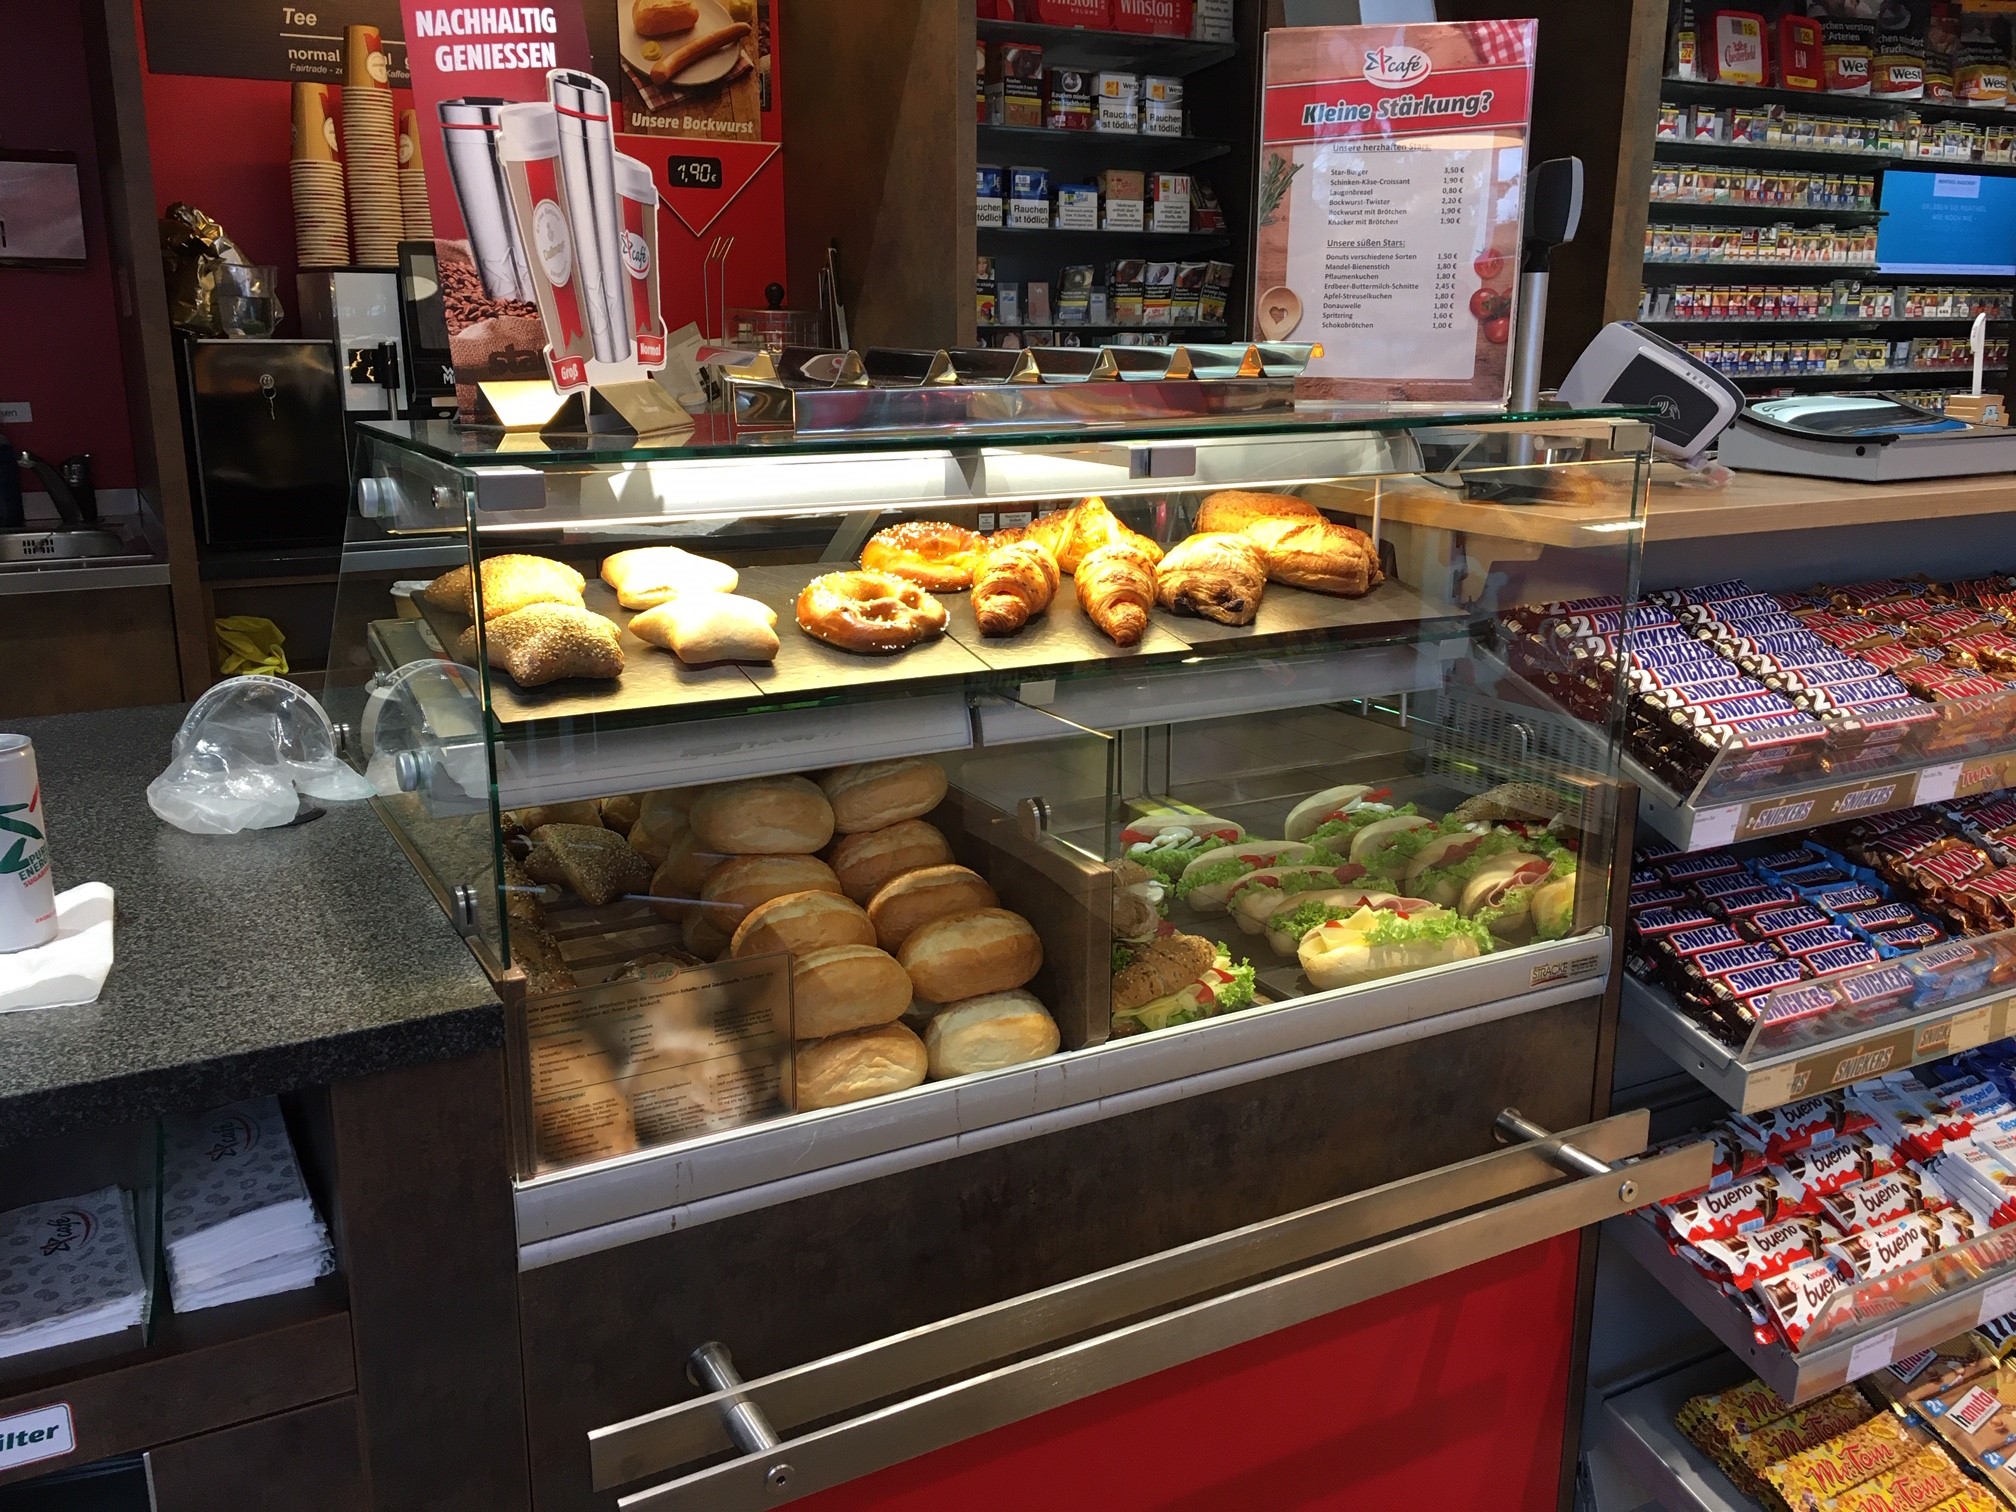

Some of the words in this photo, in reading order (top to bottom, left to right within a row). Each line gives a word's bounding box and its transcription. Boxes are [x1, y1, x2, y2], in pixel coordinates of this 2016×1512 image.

[283, 8, 317, 26] Tee
[415, 8, 557, 37] NACHHALTIG
[288, 49, 340, 62] normal
[290, 63, 327, 74] Fairtrade
[435, 42, 556, 72] GENIESSEN
[1388, 55, 1422, 78] café
[1893, 69, 1921, 79] West
[1103, 110, 1136, 122] Rauchen
[1303, 101, 1371, 124] Kleine
[1377, 91, 1493, 119] Stärkung?
[632, 113, 679, 129] Unsere
[683, 116, 753, 133] Bockwurst
[1333, 144, 1361, 152] Unsere
[1363, 143, 1406, 152] herzhaften
[1014, 205, 1047, 214] Rauchen
[1357, 239, 1380, 247] süßen
[1383, 239, 1405, 247] Stars:
[632, 247, 647, 269] café
[1322, 312, 1353, 320] Spritzring
[640, 344, 661, 356] Normal
[561, 364, 578, 380] Groß
[1710, 595, 1780, 621] SNICKERS
[1729, 612, 1803, 636] SNICKERS
[1905, 607, 1981, 637] TWIX
[1636, 642, 1716, 668] SNICKERS
[1753, 630, 1825, 654] SNICKERS
[1774, 647, 1848, 667] SNICKERS
[1656, 658, 1738, 686] SNICKERS
[1804, 658, 1878, 685] SNICKERS
[1681, 677, 1766, 701] SNICKERS
[1829, 675, 1906, 704] SNICKERS
[1710, 694, 1793, 720] SNICKERS
[1841, 785, 1894, 812] SNICKERS
[1756, 802, 1813, 828] SNICKERS
[1908, 846, 1984, 885] TWIX
[1533, 962, 1568, 979] STRACKE
[1834, 1048, 1894, 1082] SNICKERS
[1781, 1098, 1822, 1124] bueno
[1811, 1144, 1850, 1173] bueno
[1705, 1184, 1753, 1214] bueno
[1859, 1182, 1900, 1213] bueno
[1753, 1225, 1798, 1252] bueno
[1876, 1227, 1919, 1265] bueno
[1803, 1270, 1844, 1308] bueno
[1950, 1390, 1995, 1428] hanuta
